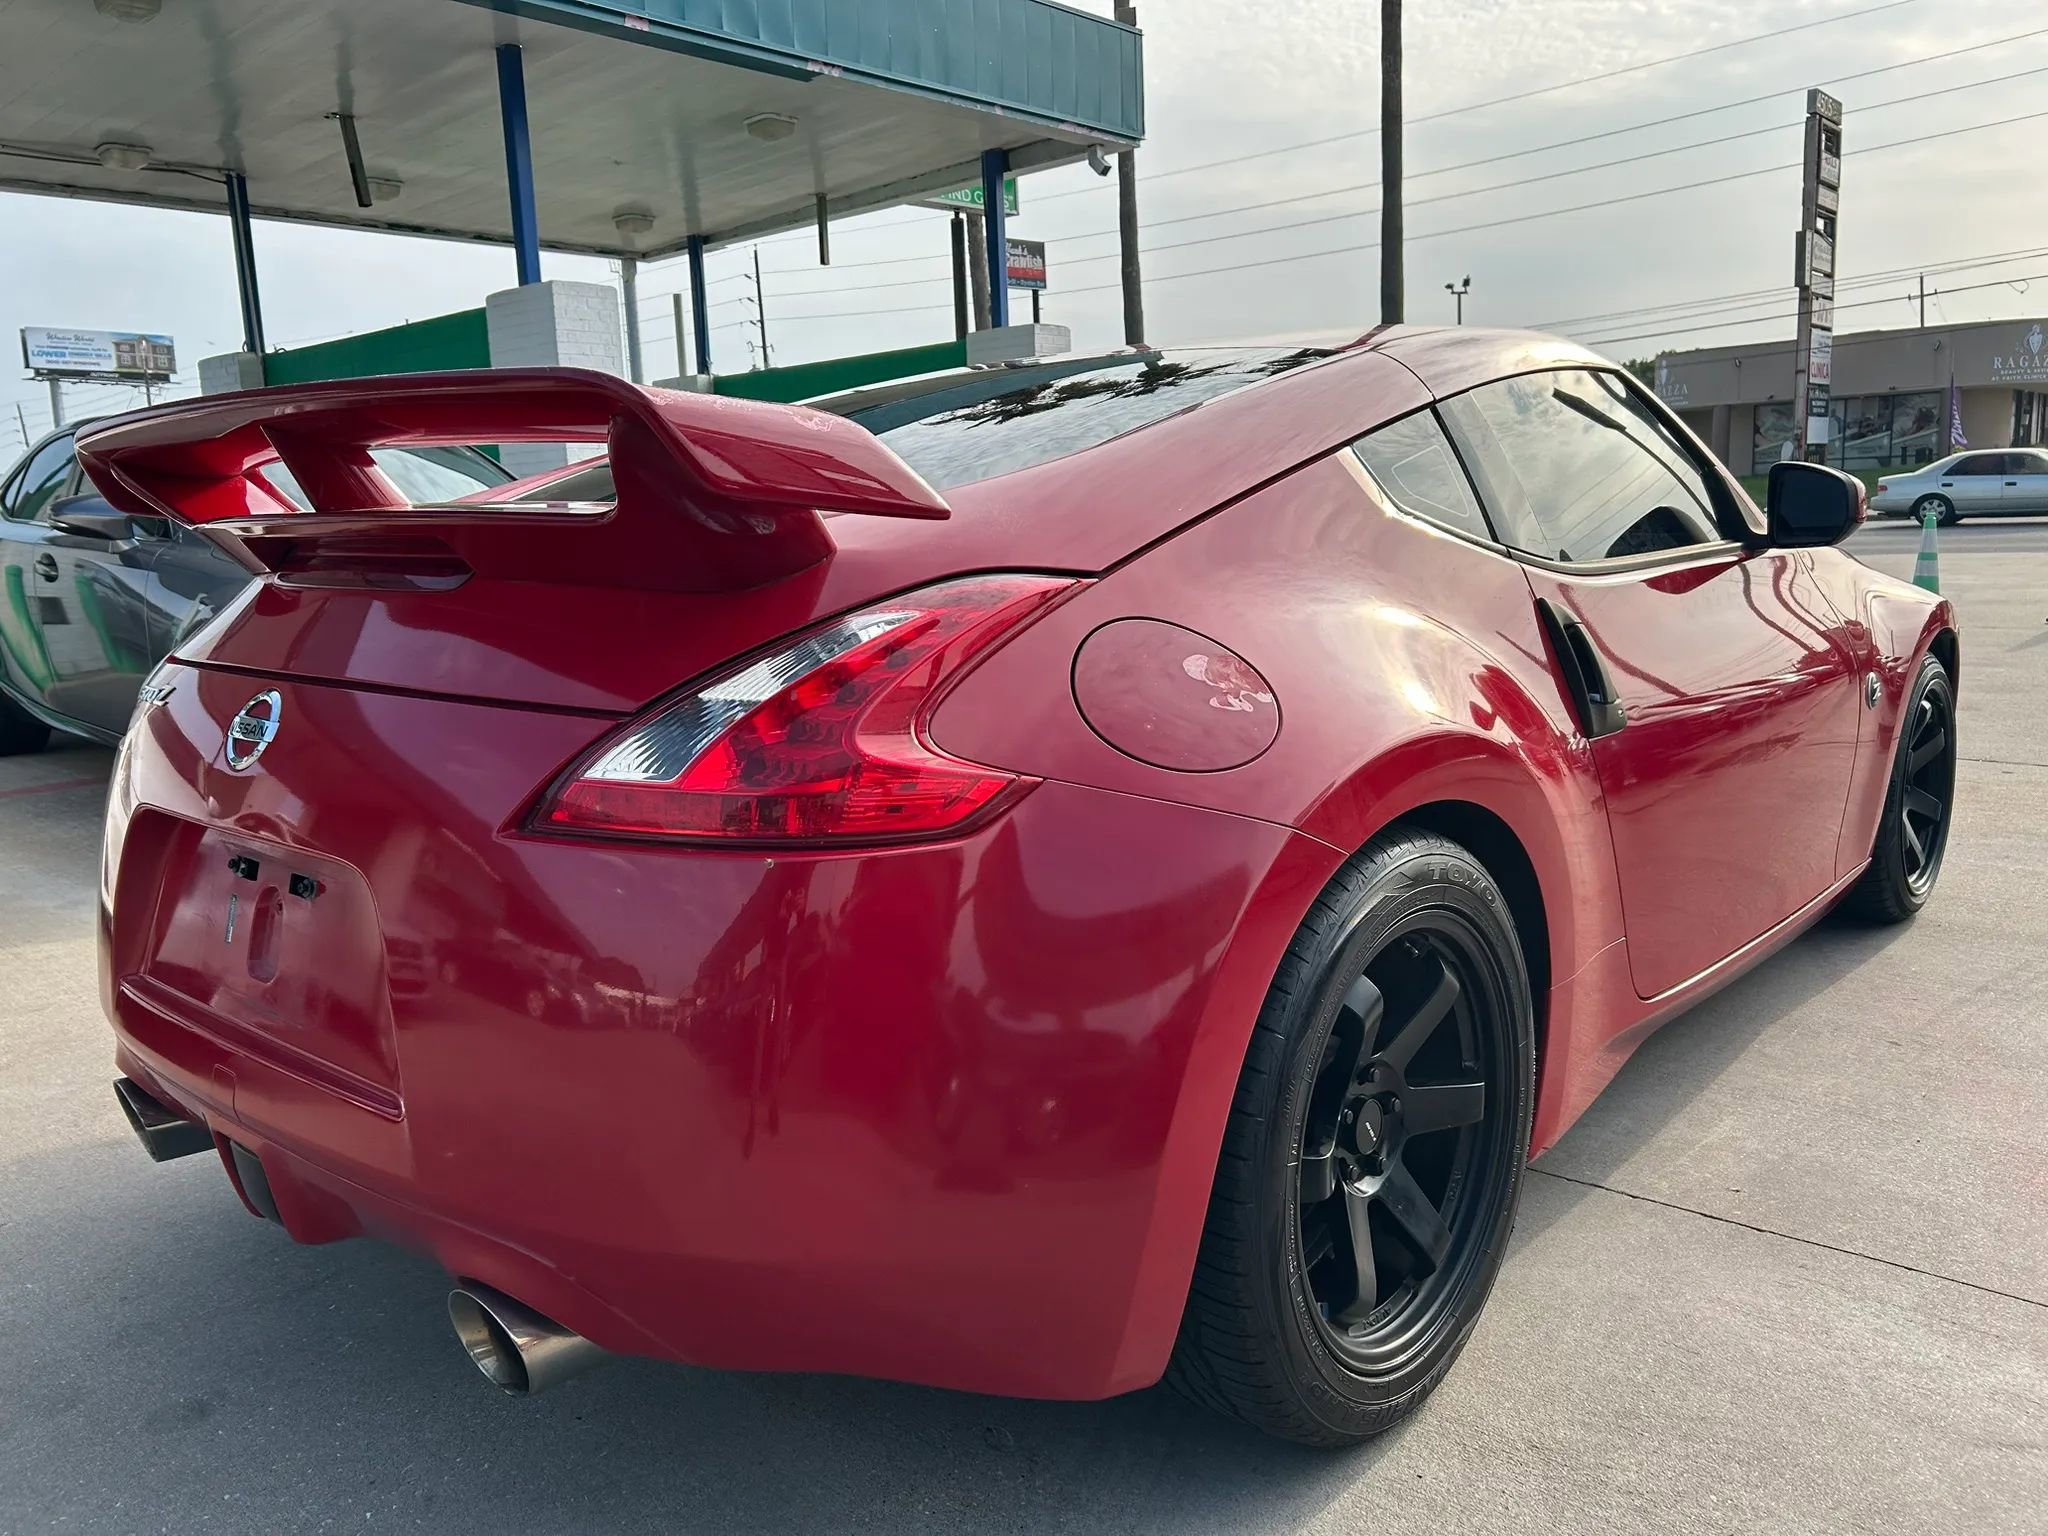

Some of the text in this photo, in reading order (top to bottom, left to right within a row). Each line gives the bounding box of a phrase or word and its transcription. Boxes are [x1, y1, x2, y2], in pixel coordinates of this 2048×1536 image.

[32, 350, 66, 358] LOWER
[229, 716, 269, 738] NISSAN
[1425, 860, 1498, 908] TOYO
